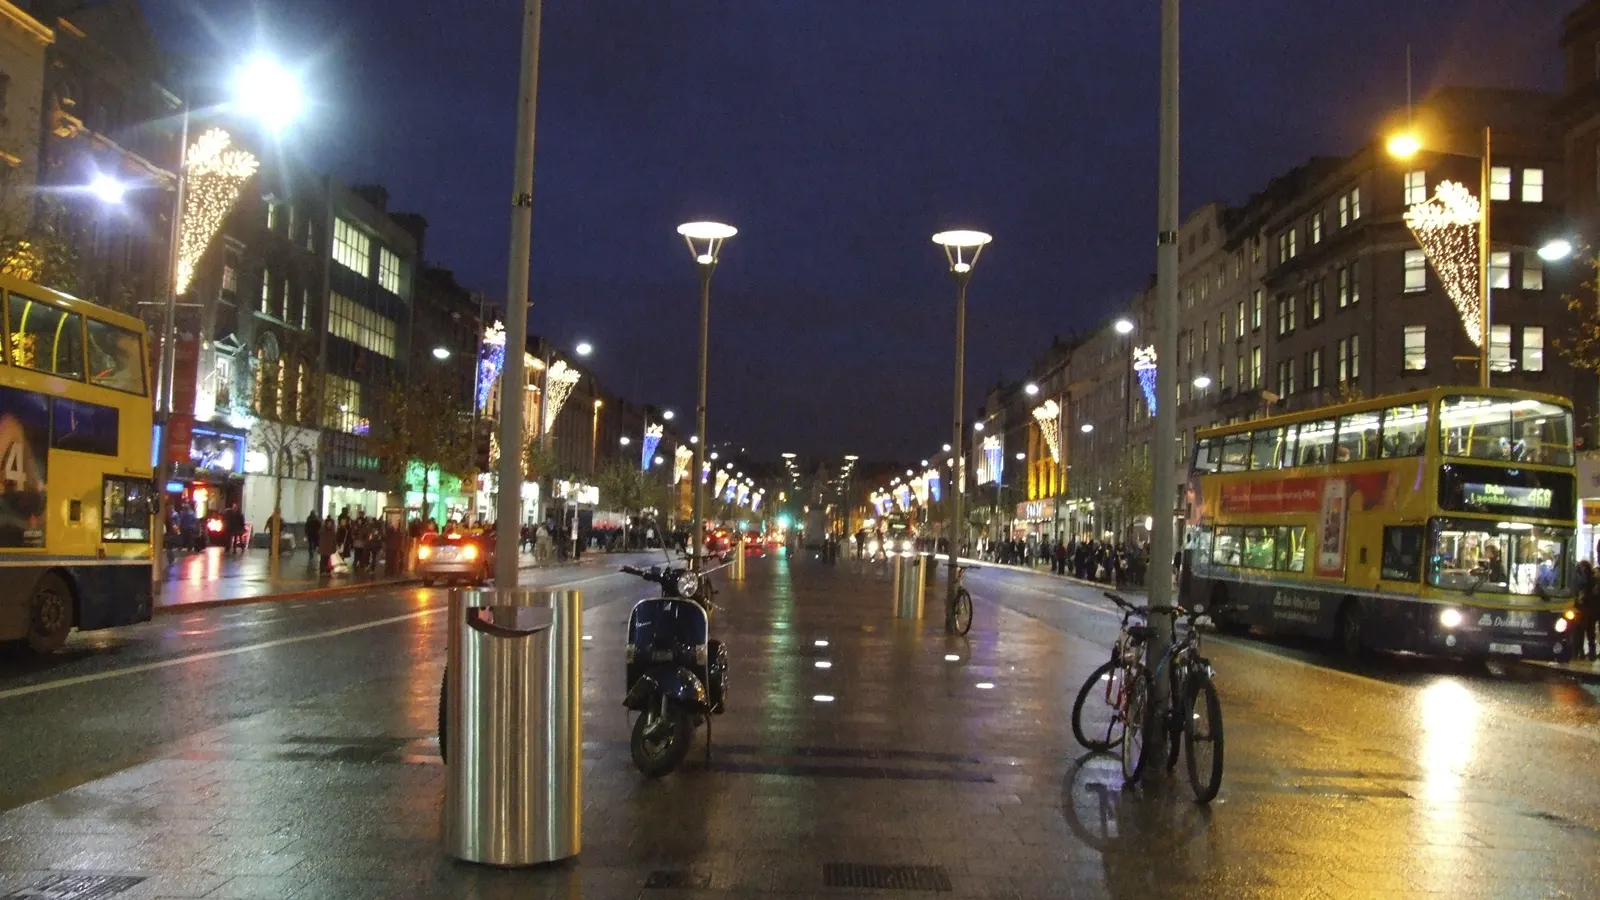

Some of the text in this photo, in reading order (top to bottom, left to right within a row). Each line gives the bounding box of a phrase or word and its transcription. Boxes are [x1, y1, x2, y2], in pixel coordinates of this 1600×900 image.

[5, 442, 26, 491] 4
[1528, 488, 1551, 508] 46A
[1494, 616, 1535, 629] Dublin Bus
